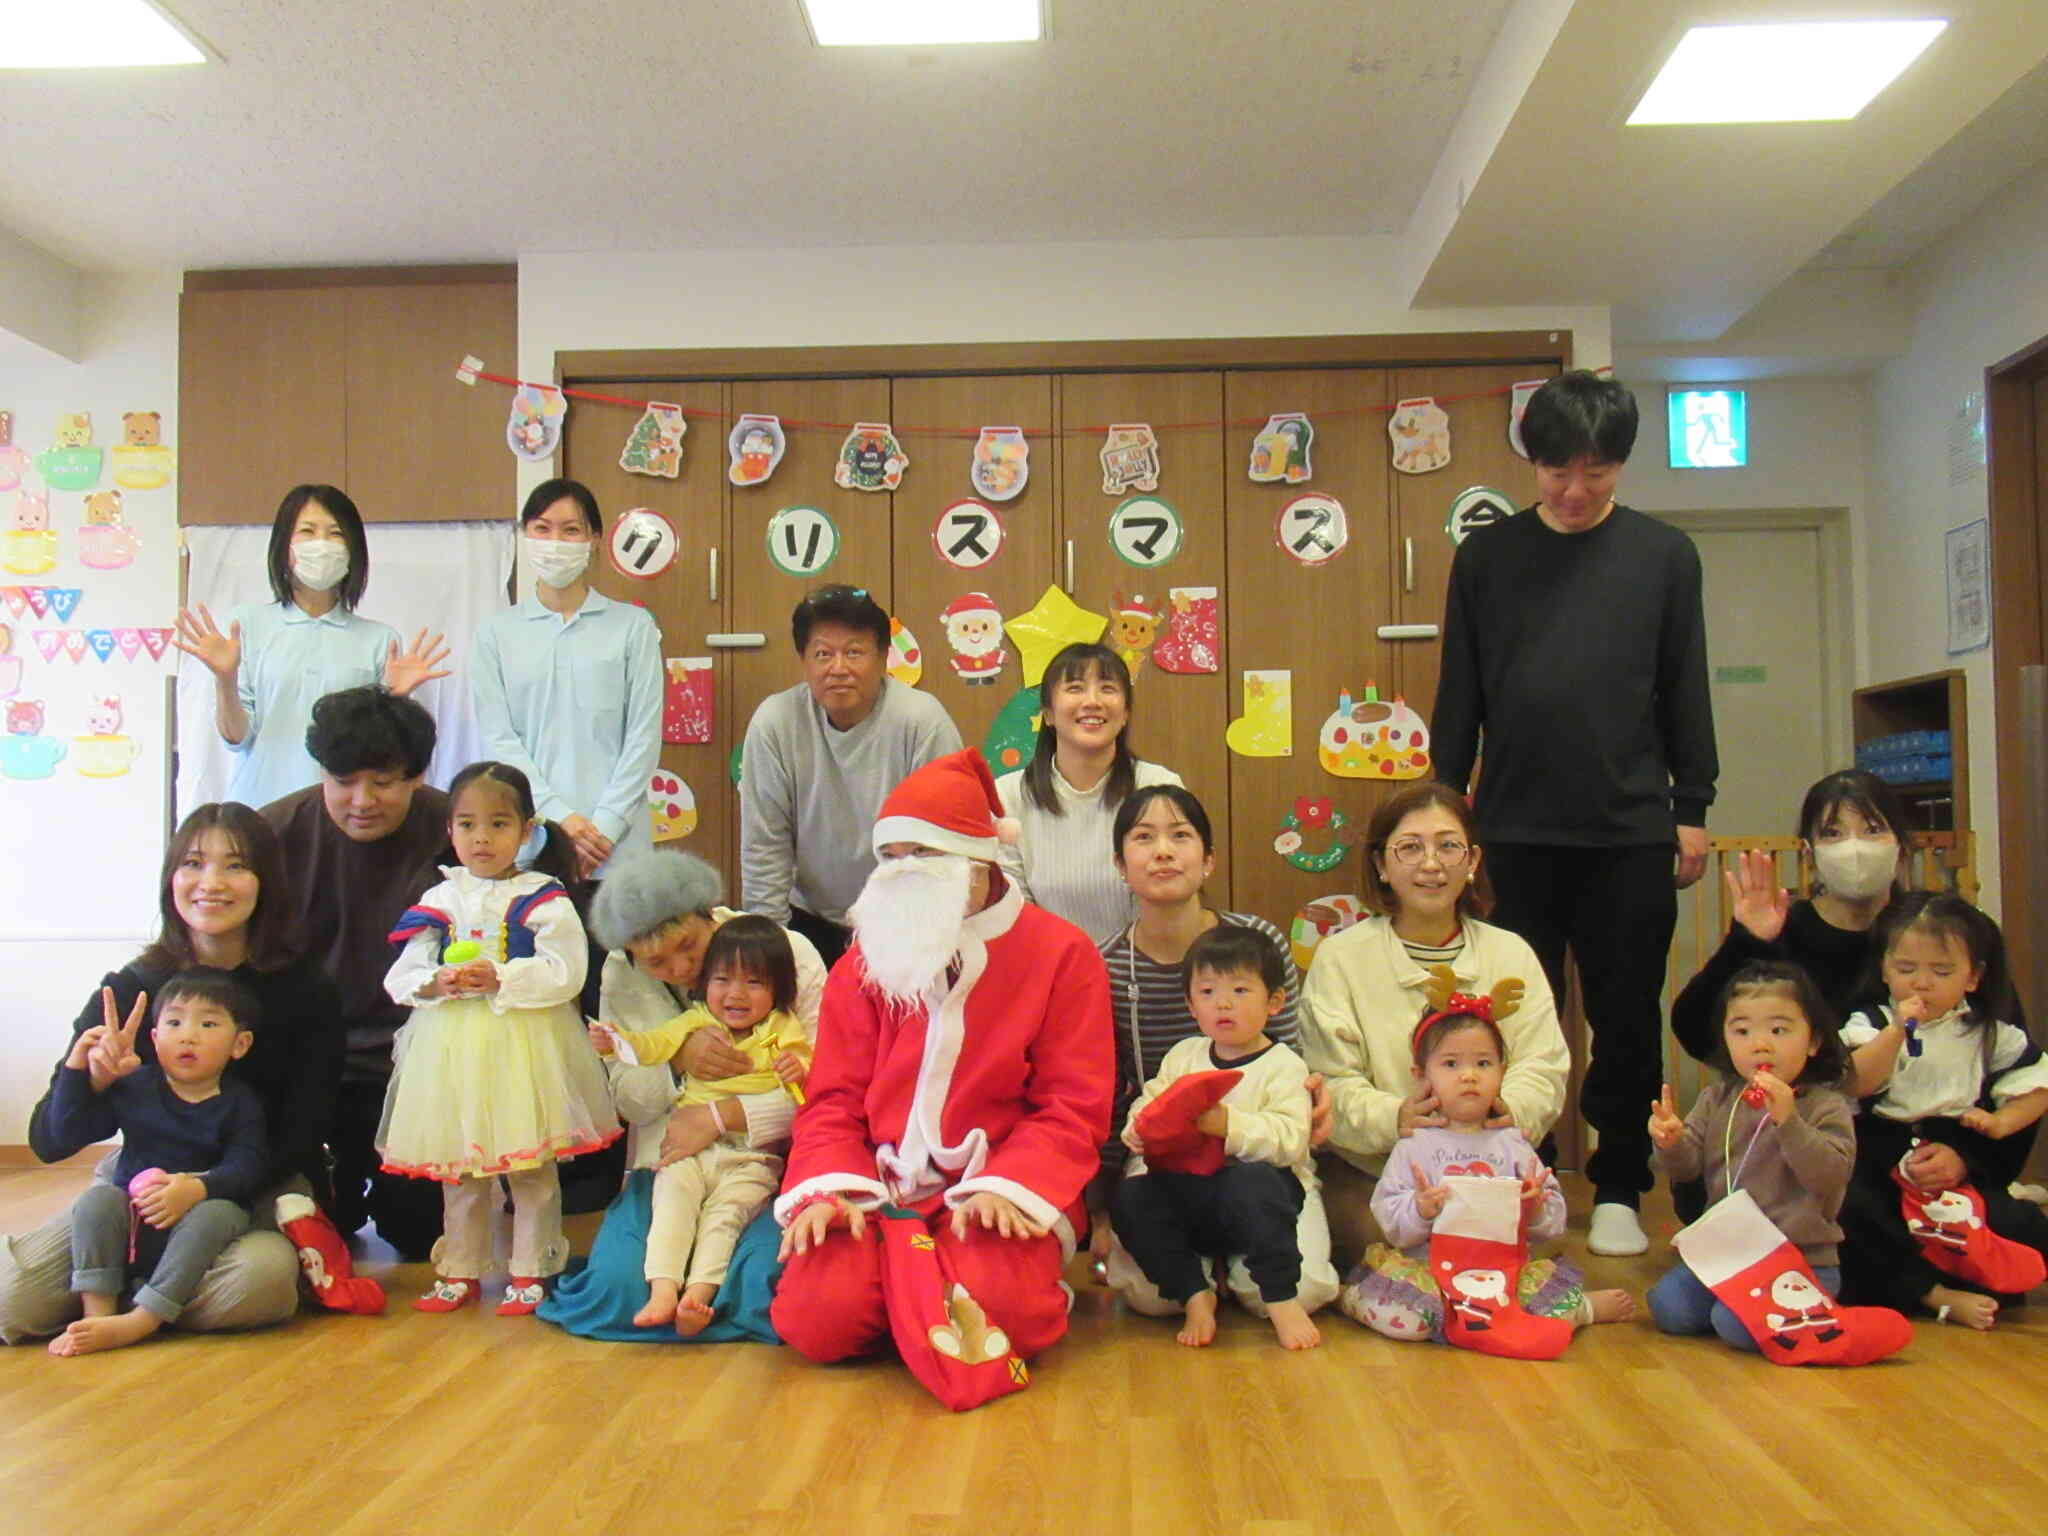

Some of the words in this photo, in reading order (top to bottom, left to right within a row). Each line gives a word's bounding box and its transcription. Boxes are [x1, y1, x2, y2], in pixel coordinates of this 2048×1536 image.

[11, 589, 74, 611] うび
[38, 632, 163, 650] おめでとう
